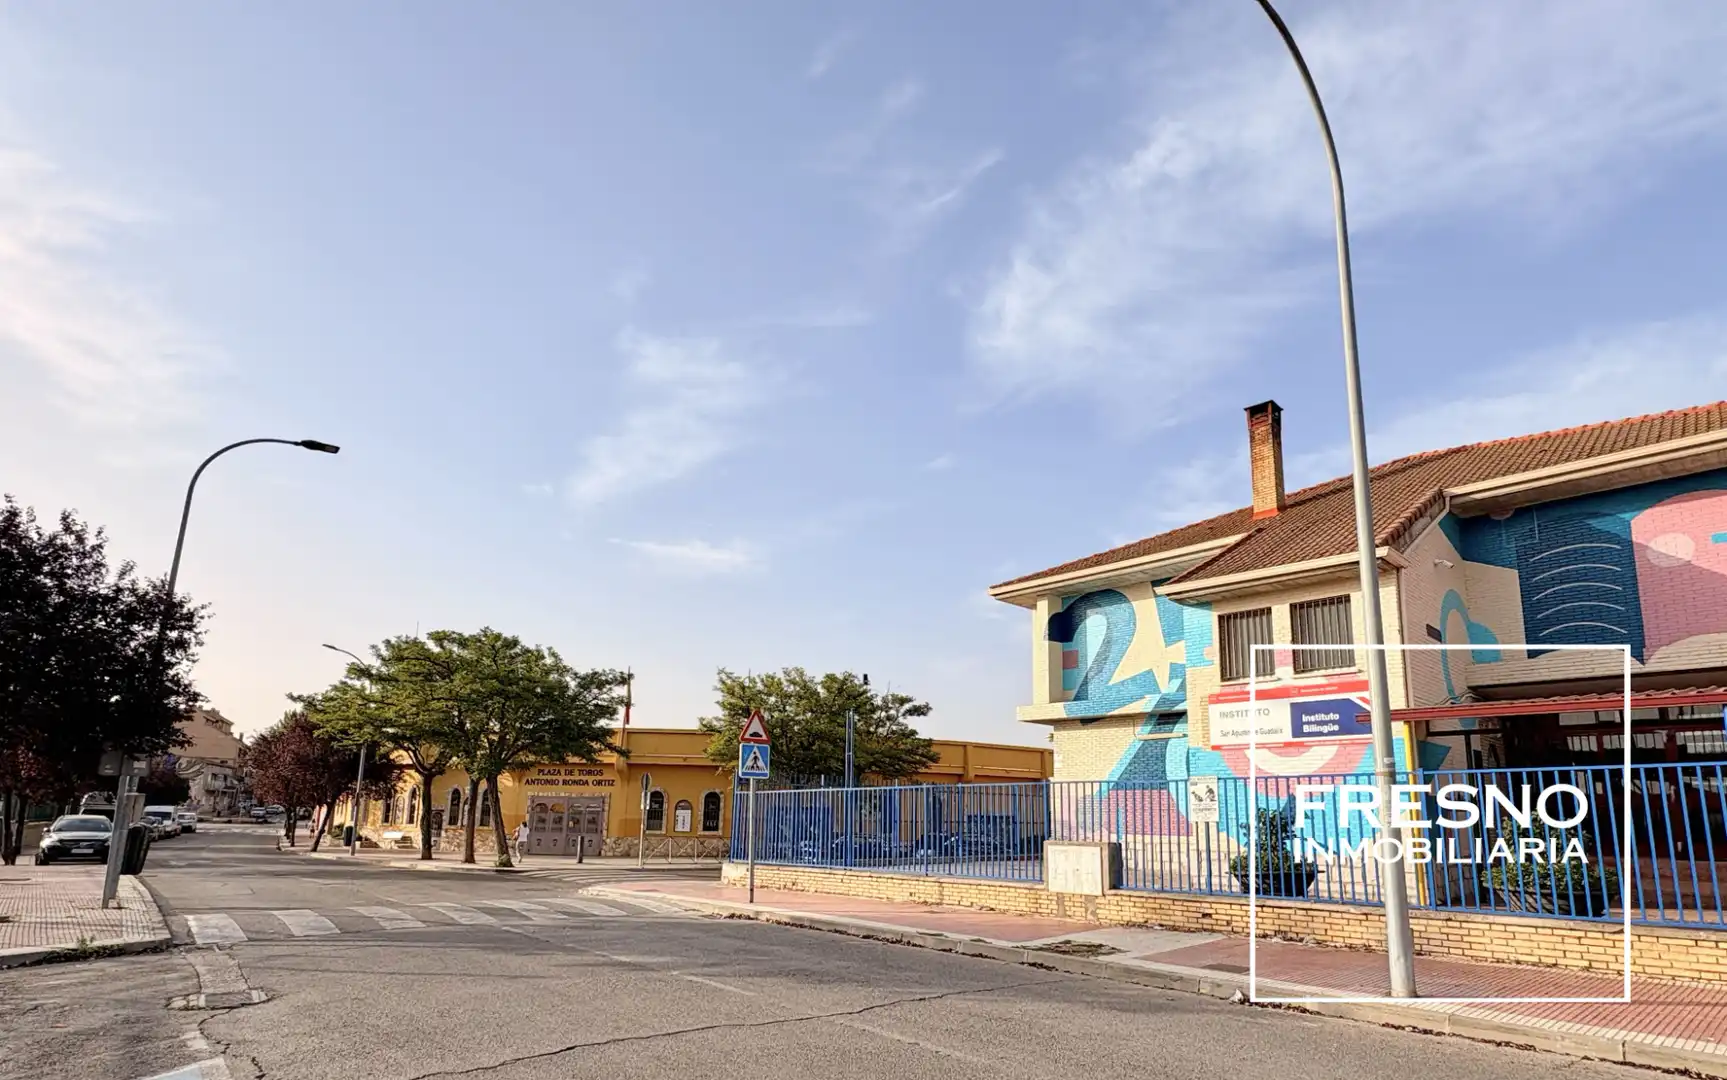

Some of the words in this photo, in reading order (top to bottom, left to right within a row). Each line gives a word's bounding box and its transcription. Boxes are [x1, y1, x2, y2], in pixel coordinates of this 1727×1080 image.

[1219, 708, 1270, 719] INSTITTO
[1302, 712, 1340, 722] Instituto
[1303, 723, 1340, 733] Bilingüe
[537, 768, 561, 776] PLAZA
[564, 768, 575, 776] DE
[577, 768, 604, 777] TOROS
[525, 778, 560, 786] ANTONIO
[562, 779, 589, 787] RONDA
[592, 779, 616, 787] ORTIZ
